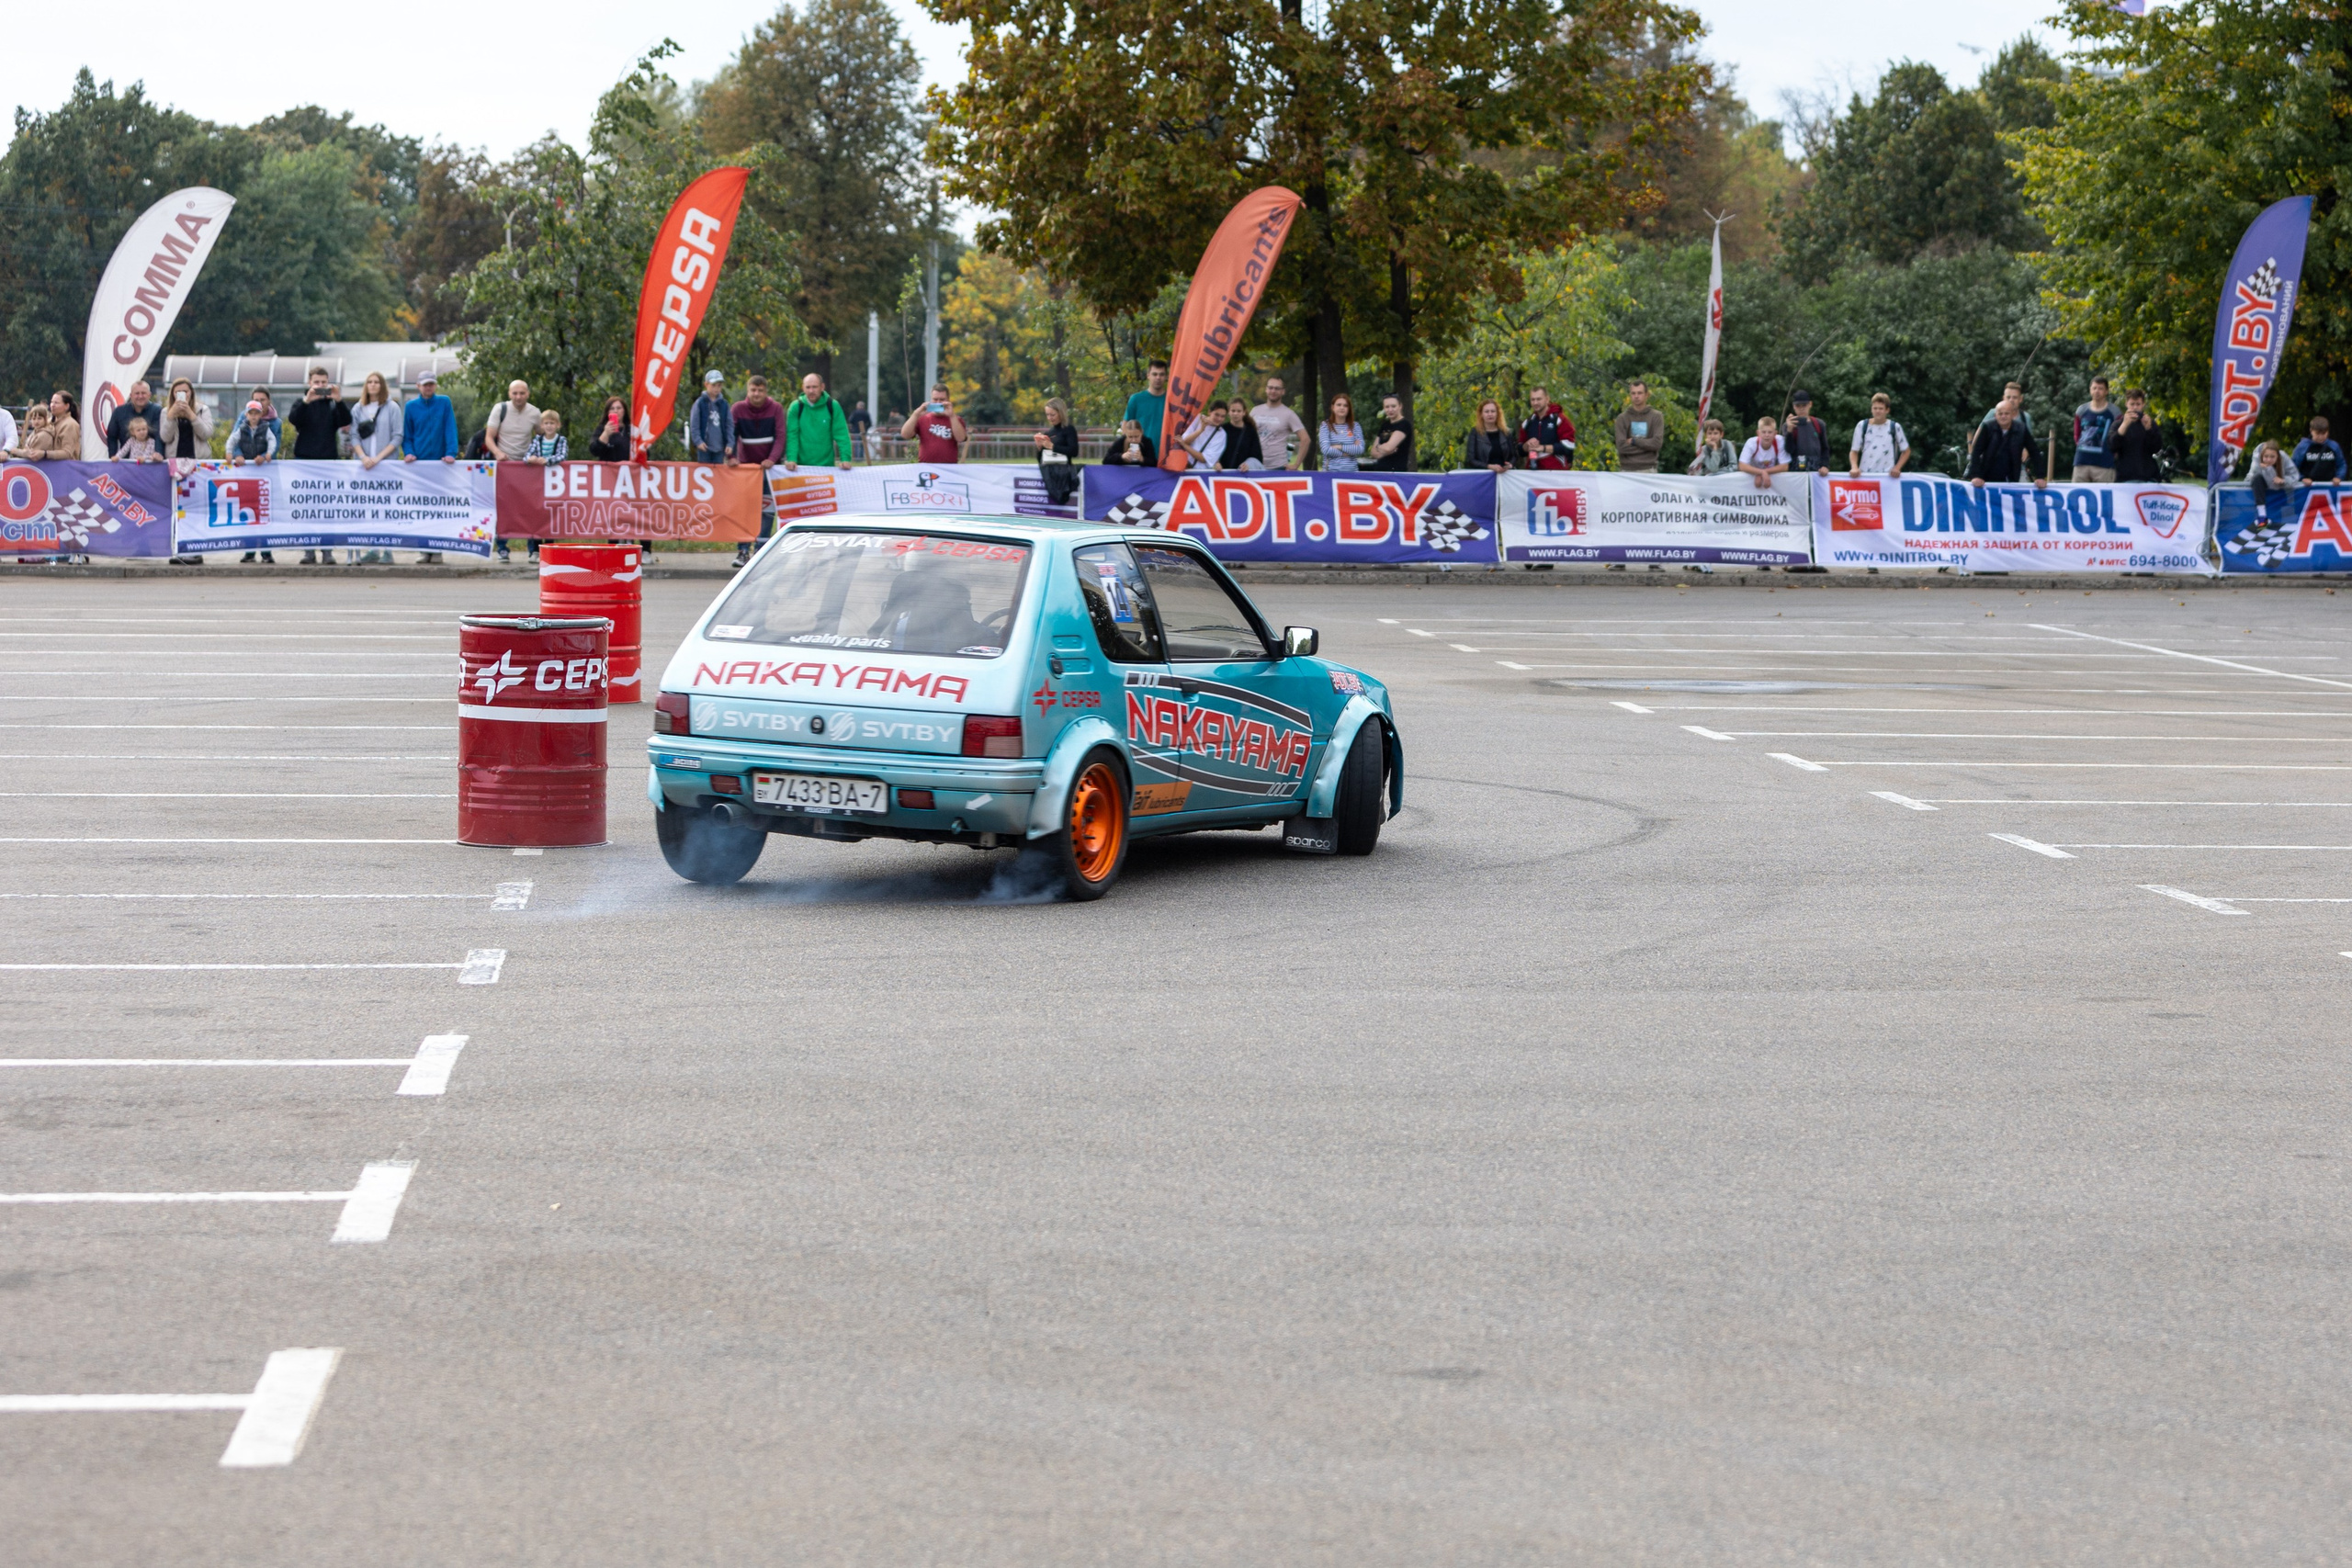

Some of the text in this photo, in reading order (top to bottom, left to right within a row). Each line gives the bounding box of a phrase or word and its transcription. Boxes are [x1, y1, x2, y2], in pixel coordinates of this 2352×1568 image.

[113, 213, 212, 366] COMMA
[1194, 206, 1288, 383] lubricants
[645, 207, 721, 399] CEPSA
[2218, 280, 2277, 450] ADT.BY
[291, 479, 403, 491] ФЛАГИ И ФЛАЖКИ
[544, 464, 714, 502] BELARUS
[87, 472, 157, 527] ADT.BY
[289, 493, 470, 506] КОРПОРАТИВНАЯ СИМВОЛИКА
[1711, 494, 1788, 506] ФЛАГШТОКИ
[1834, 486, 1878, 504] Pyrmo
[1164, 475, 1442, 546] ADT.BY
[1900, 479, 2131, 534] DINITROL
[291, 509, 469, 520] ФЛАГШТОКИ И КОНСТРУКЦИИ
[544, 500, 714, 537] TRACTORS
[1600, 512, 1790, 525] КОРПОРАТИВНАЯ СИМВОЛИКА
[2150, 512, 2175, 522] Dinol
[187, 539, 242, 550] WWW.FLAG.BY
[266, 536, 322, 545] WWW.FLAG.BY
[347, 536, 402, 545] WWW.FLAG.BY
[428, 539, 482, 551] WWW.FLAG.BY
[1905, 538, 2133, 550] НАДЕЖНАЯ ЗАЩИТА ОТ КОРРОЗИИ
[932, 540, 1027, 563] CEPSA
[1528, 548, 1600, 558] WWW.FLAG.BY
[1625, 549, 1696, 558] WWW.FLAG.BY
[1721, 551, 1789, 563] WWW.FLAG.BY
[1834, 550, 1969, 565] WWW.DINITROL.BY
[2129, 555, 2198, 568] 694-8000
[845, 637, 892, 648] parts
[693, 660, 970, 704] NAKAYAMA
[1061, 691, 1102, 708] CEPSA
[722, 710, 956, 742] SVT.BY SVT.BY
[1125, 690, 1312, 779] NAKAYAMA
[774, 777, 881, 808] 7433 BA-7
[1286, 836, 1330, 848] sparco
